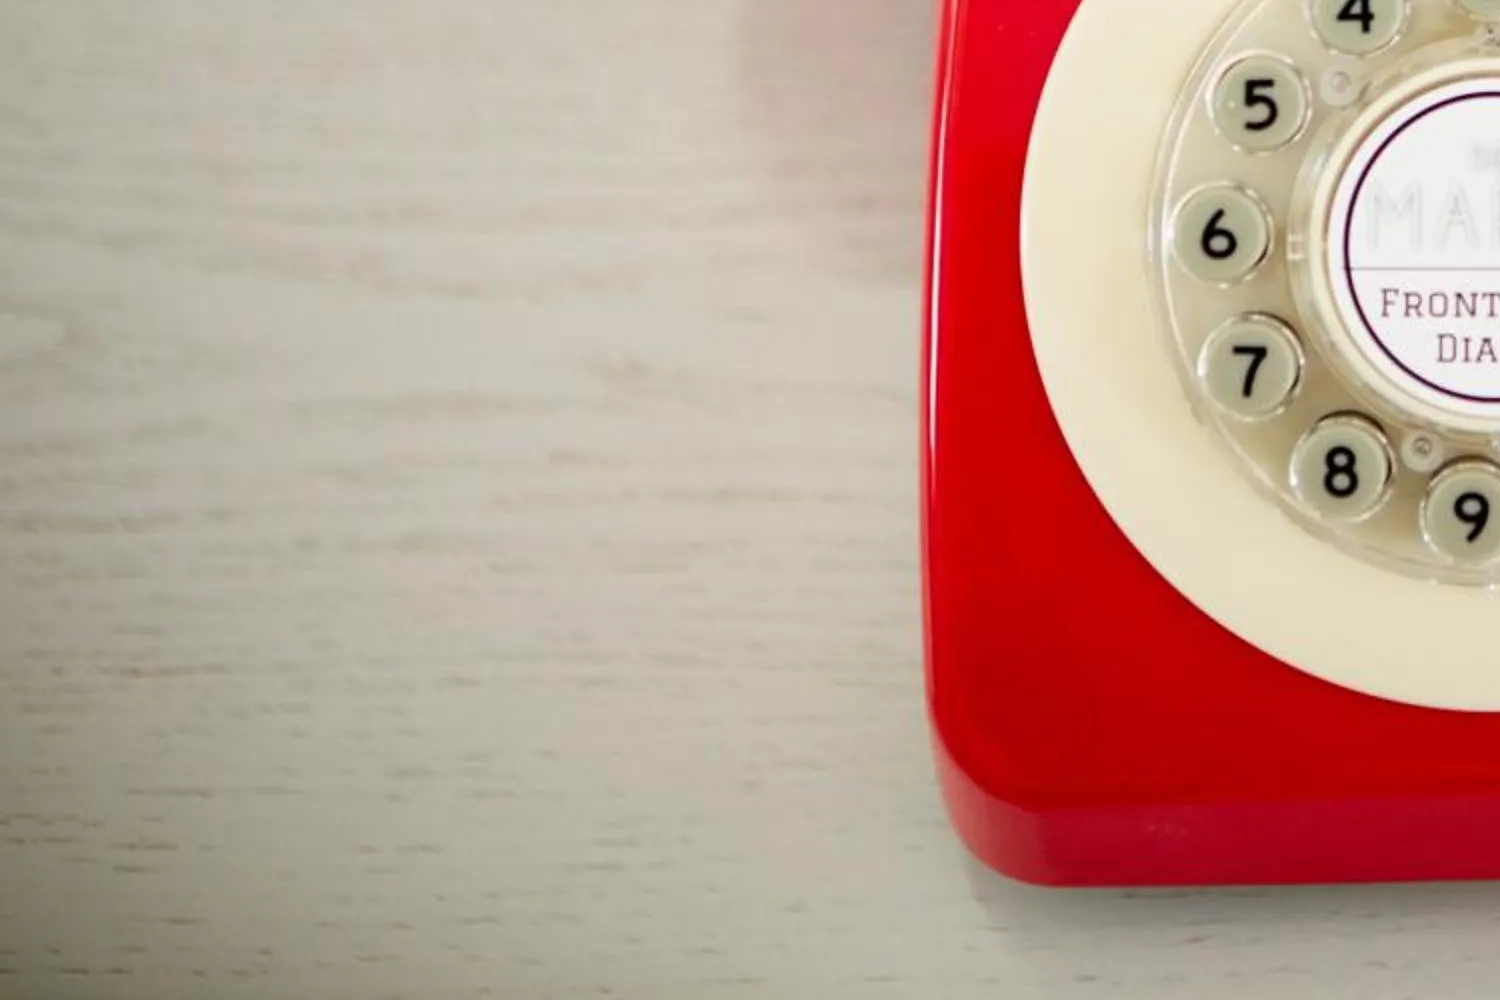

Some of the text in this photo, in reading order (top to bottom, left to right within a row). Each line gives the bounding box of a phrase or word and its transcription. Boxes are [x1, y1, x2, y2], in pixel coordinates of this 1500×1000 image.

[1243, 78, 1279, 132] 5
[1200, 208, 1238, 261] 6
[1231, 345, 1268, 398] 7
[1323, 445, 1359, 499] 8
[1452, 491, 1490, 544] 9
